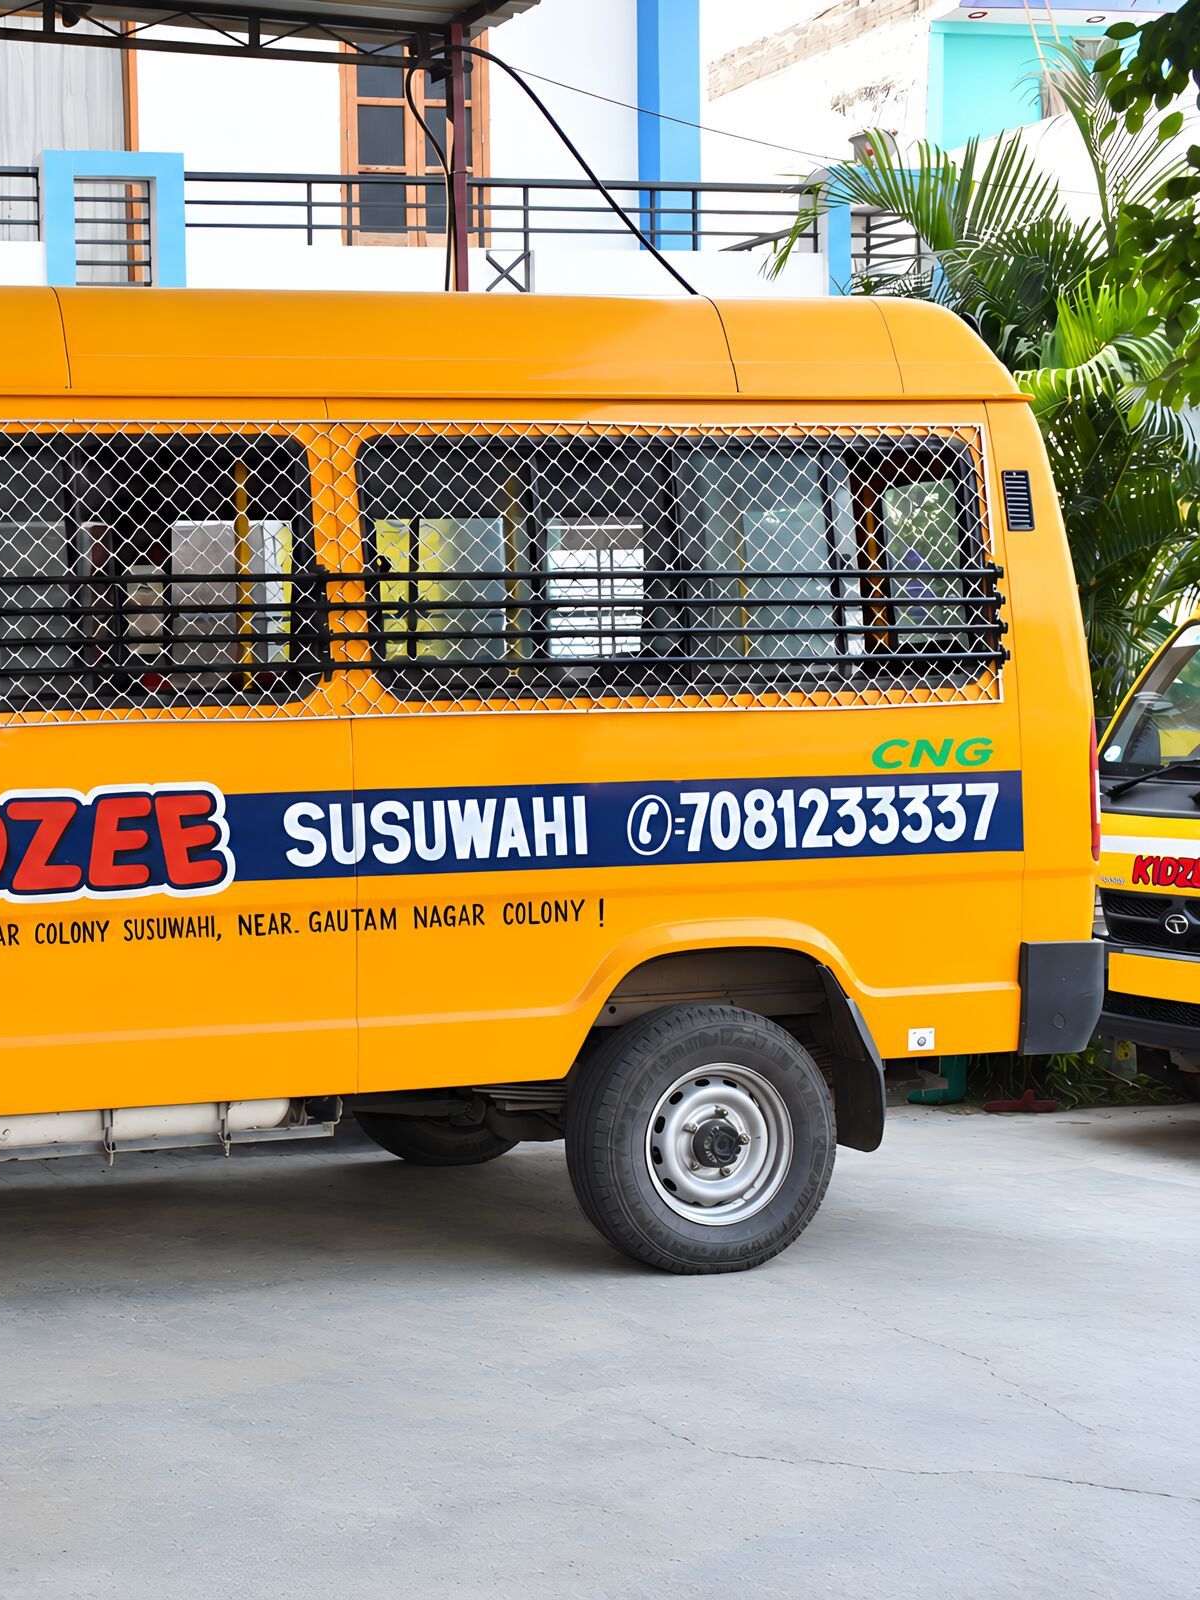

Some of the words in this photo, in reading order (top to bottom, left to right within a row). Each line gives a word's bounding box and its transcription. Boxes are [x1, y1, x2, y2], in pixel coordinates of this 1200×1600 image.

[871, 737, 993, 769] CNG
[283, 795, 588, 867] SUSUWAHI
[1132, 855, 1200, 888] KIDZ
[34, 919, 110, 944] COLONY
[123, 915, 222, 942] SUSUWAHI,
[309, 907, 398, 933] GAUTAM
[413, 903, 486, 930] NAGAR
[502, 899, 585, 925] COLONY
